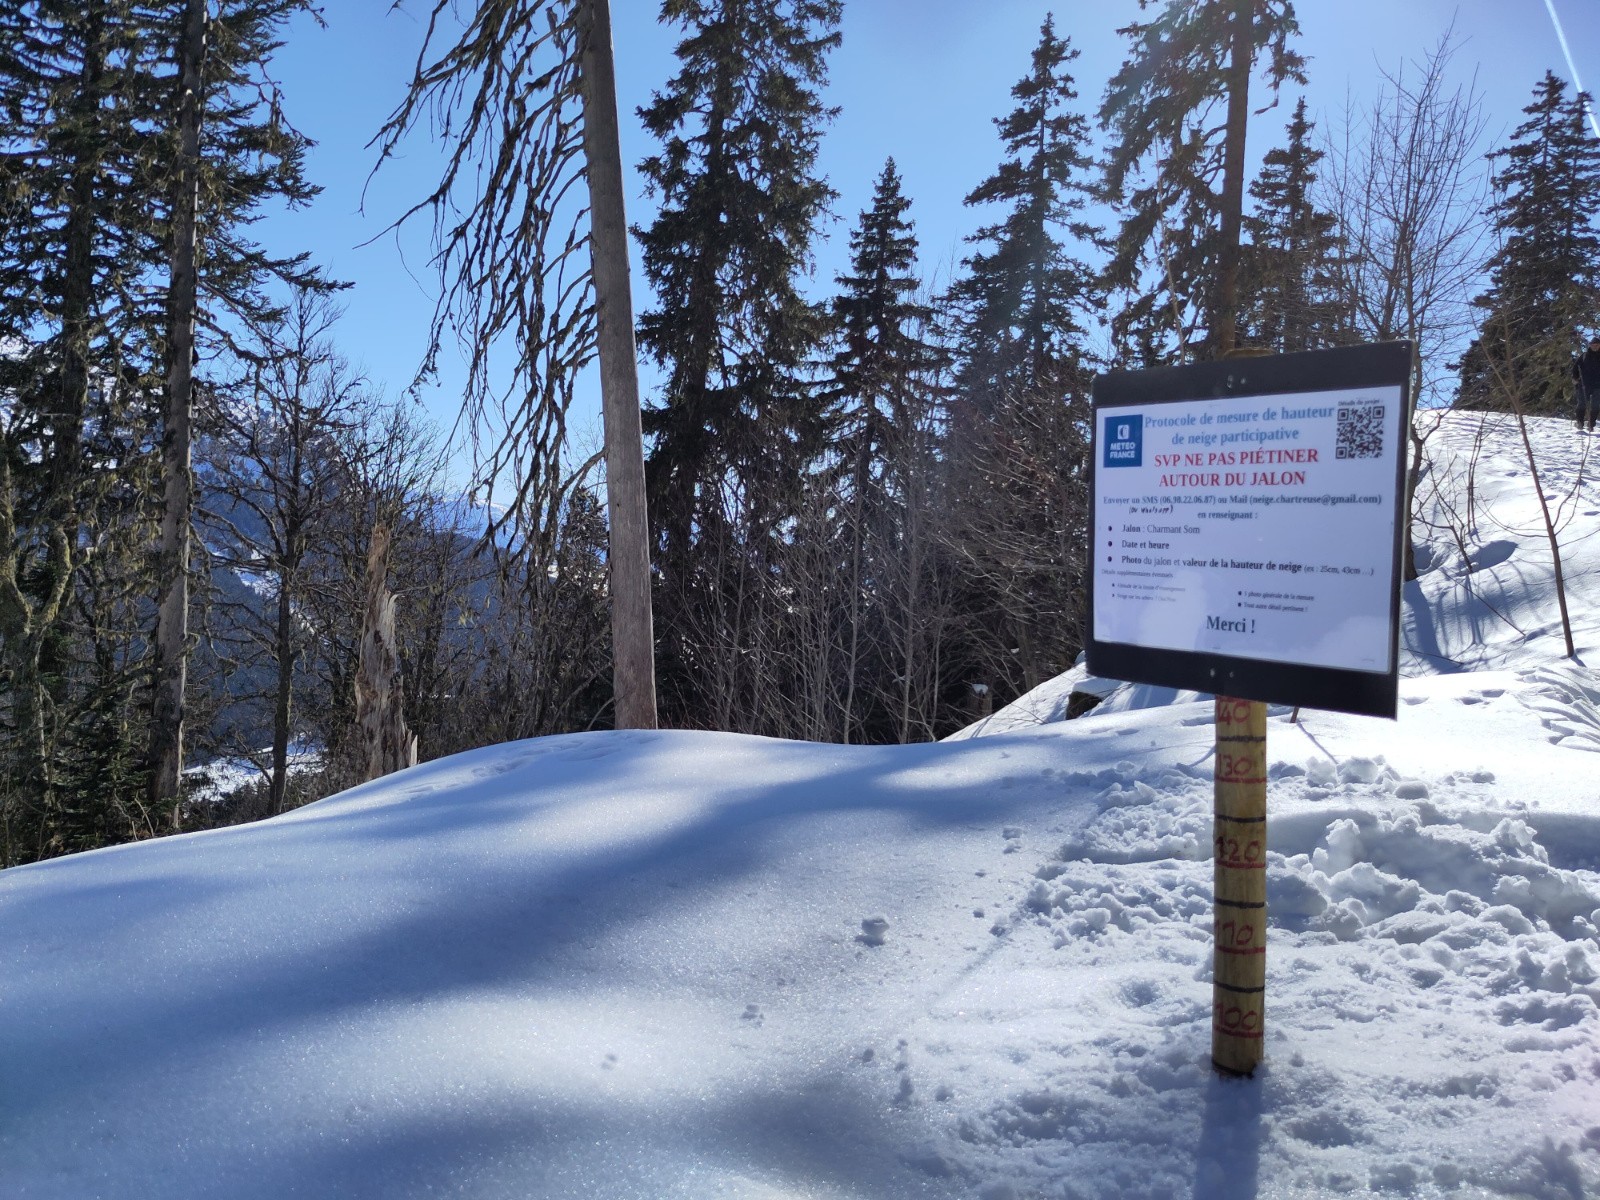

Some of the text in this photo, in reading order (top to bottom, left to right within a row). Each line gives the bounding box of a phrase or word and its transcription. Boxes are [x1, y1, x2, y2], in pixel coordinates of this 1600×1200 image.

[1144, 405, 1335, 428] Protocole de mesure de hauteur
[1171, 427, 1299, 447] de neige participative
[1109, 450, 1135, 459] FRANCE
[1154, 447, 1319, 468] SVP NE PAS PIÉTINER
[1158, 470, 1306, 488] AUTOUR DU JALON
[1141, 495, 1158, 504] SMS
[1217, 496, 1227, 504] ou
[1229, 494, 1248, 504] Mail
[1197, 511, 1206, 519] en
[1208, 510, 1253, 521] renseignant
[1121, 523, 1140, 533] Jalon
[1146, 523, 1182, 534] Charmant
[1183, 524, 1200, 534] Som
[1121, 539, 1170, 550] Date et heure
[1121, 555, 1142, 564] Photo
[1143, 556, 1152, 565] du
[1154, 556, 1172, 567] jalon
[1173, 558, 1181, 567] et
[1182, 558, 1207, 567] valeur
[1208, 558, 1219, 568] de
[1220, 558, 1229, 569] la
[1230, 560, 1263, 570] hauteur
[1265, 561, 1277, 571] de
[1278, 562, 1302, 573] neige
[1207, 615, 1256, 634] Merci !
[1215, 836, 1261, 862] 120
[1214, 1003, 1258, 1030] 100
